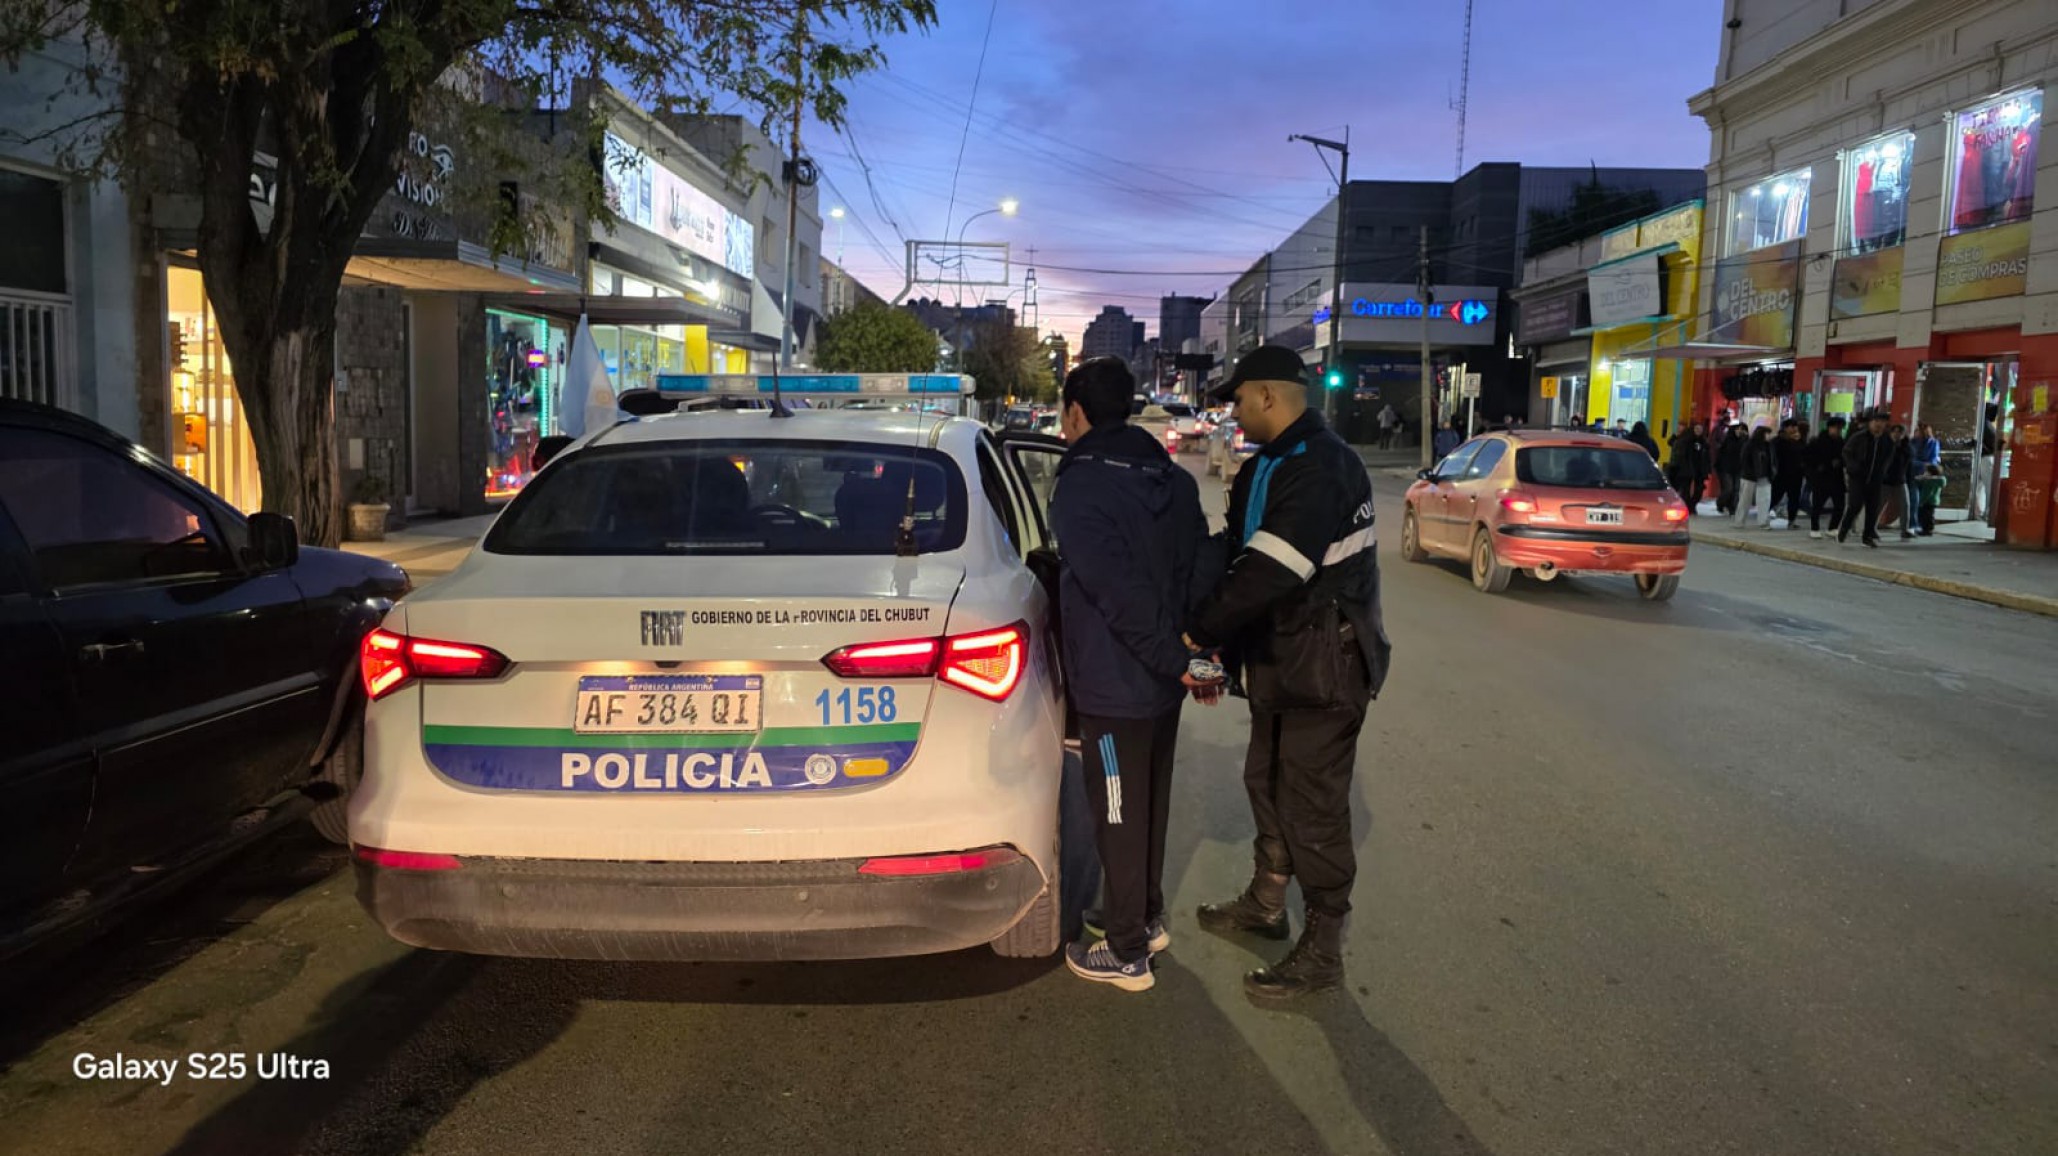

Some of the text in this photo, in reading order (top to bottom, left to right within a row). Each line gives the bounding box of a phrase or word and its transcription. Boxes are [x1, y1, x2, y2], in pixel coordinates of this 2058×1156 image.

[1959, 257, 2027, 283] COMPRAS
[1730, 288, 1789, 320] CENTRO
[1731, 278, 1756, 301] DEL
[640, 611, 685, 646] FIAT
[691, 611, 753, 624] GOBIERNO
[756, 611, 771, 624] DE
[775, 610, 790, 623] LA
[860, 609, 881, 622] DEL
[885, 608, 930, 621] CHUBUT
[584, 693, 749, 725] AF 384 QI
[816, 686, 897, 725] 1158
[561, 752, 773, 788] POLICIA
